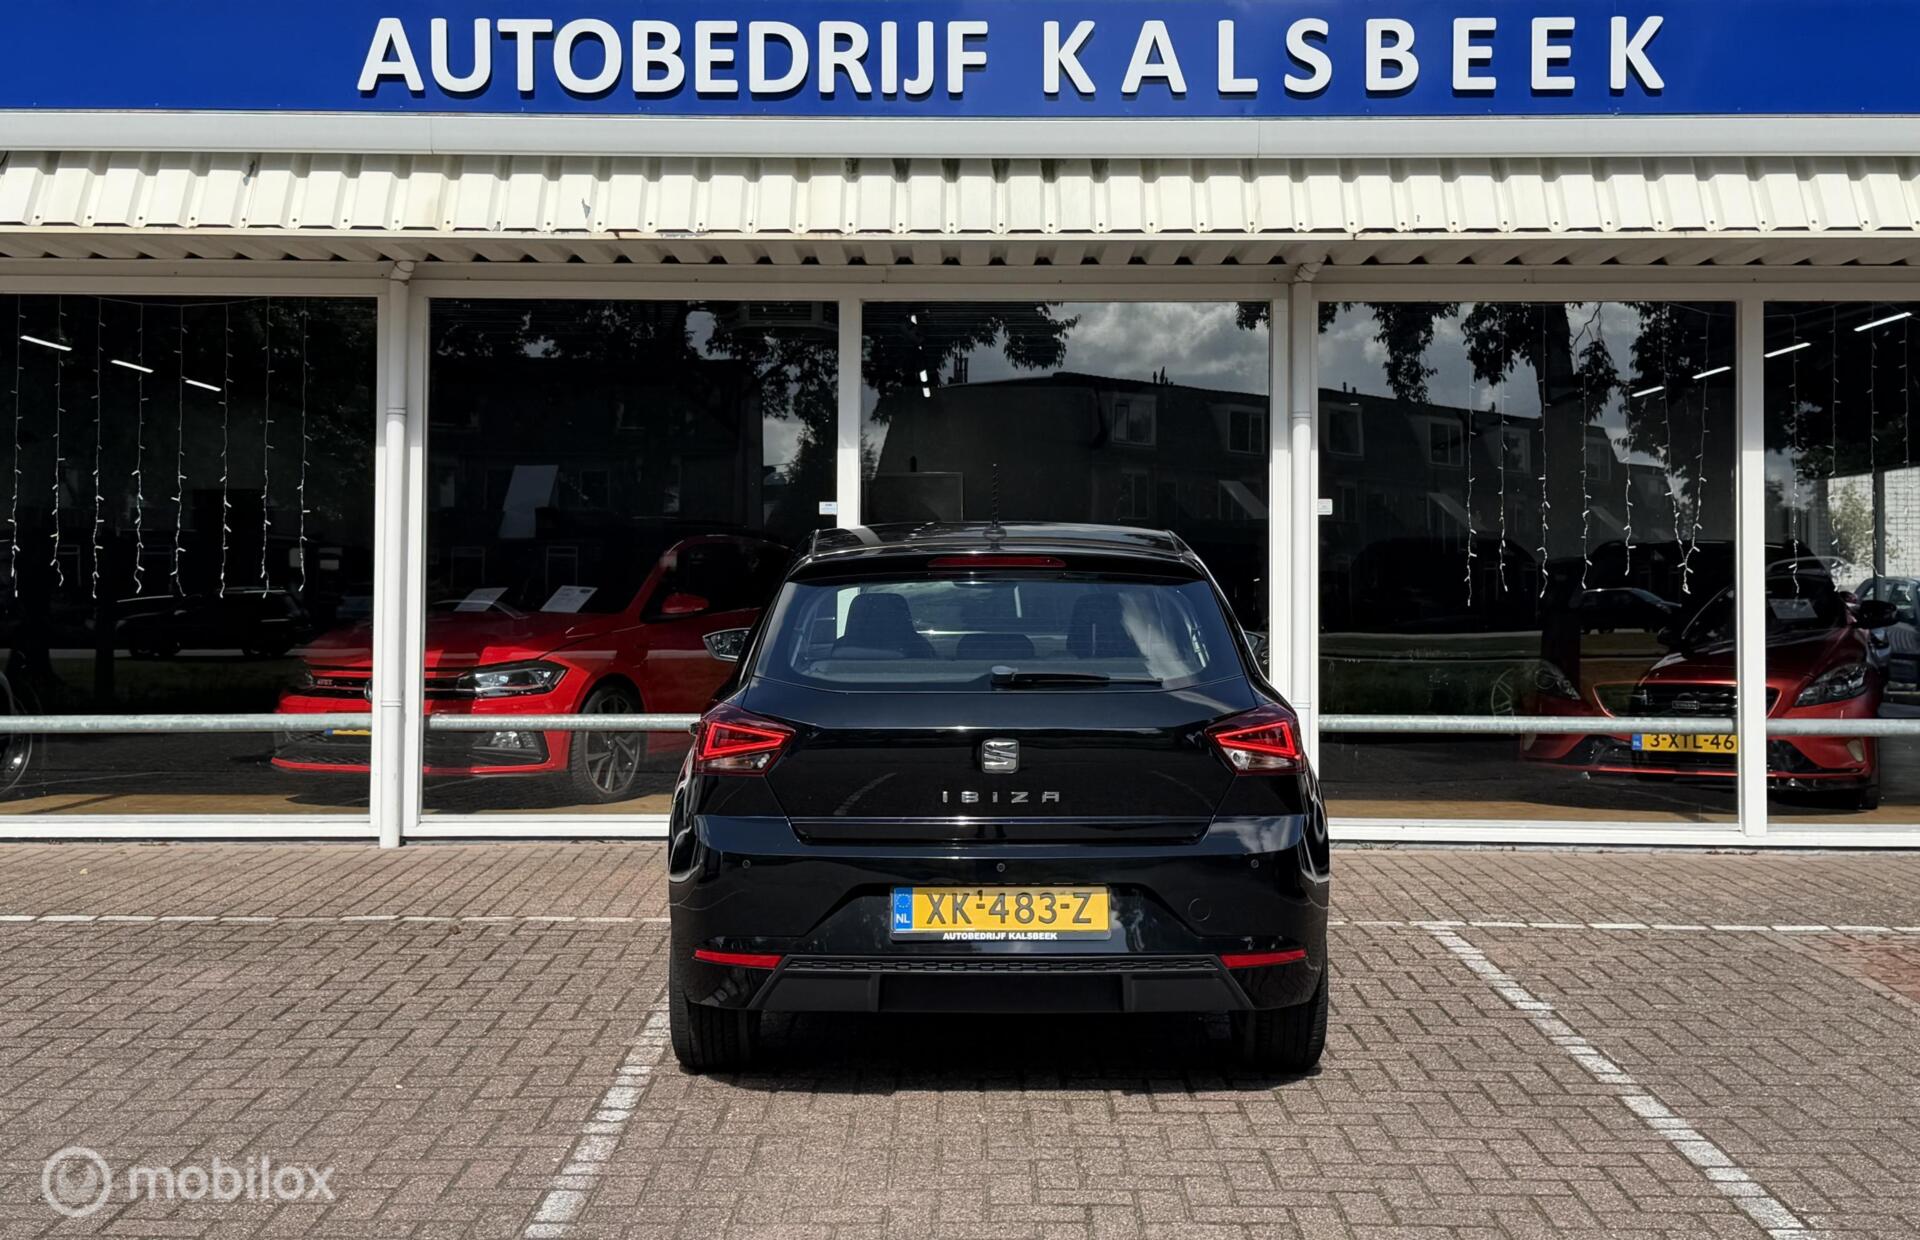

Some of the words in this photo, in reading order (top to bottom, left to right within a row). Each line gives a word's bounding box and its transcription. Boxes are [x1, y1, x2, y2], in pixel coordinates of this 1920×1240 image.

[357, 17, 989, 94] AUTOBEDRIJF
[1043, 15, 1665, 94] KALSBEEK
[1650, 734, 1735, 750] 3-XTL-46
[942, 791, 1060, 803] IBIZA
[926, 892, 1092, 925] XK-483-Z
[895, 913, 911, 924] NL
[943, 931, 1006, 940] AUTOBEDRIJF
[1008, 931, 1058, 940] KALSBEEK
